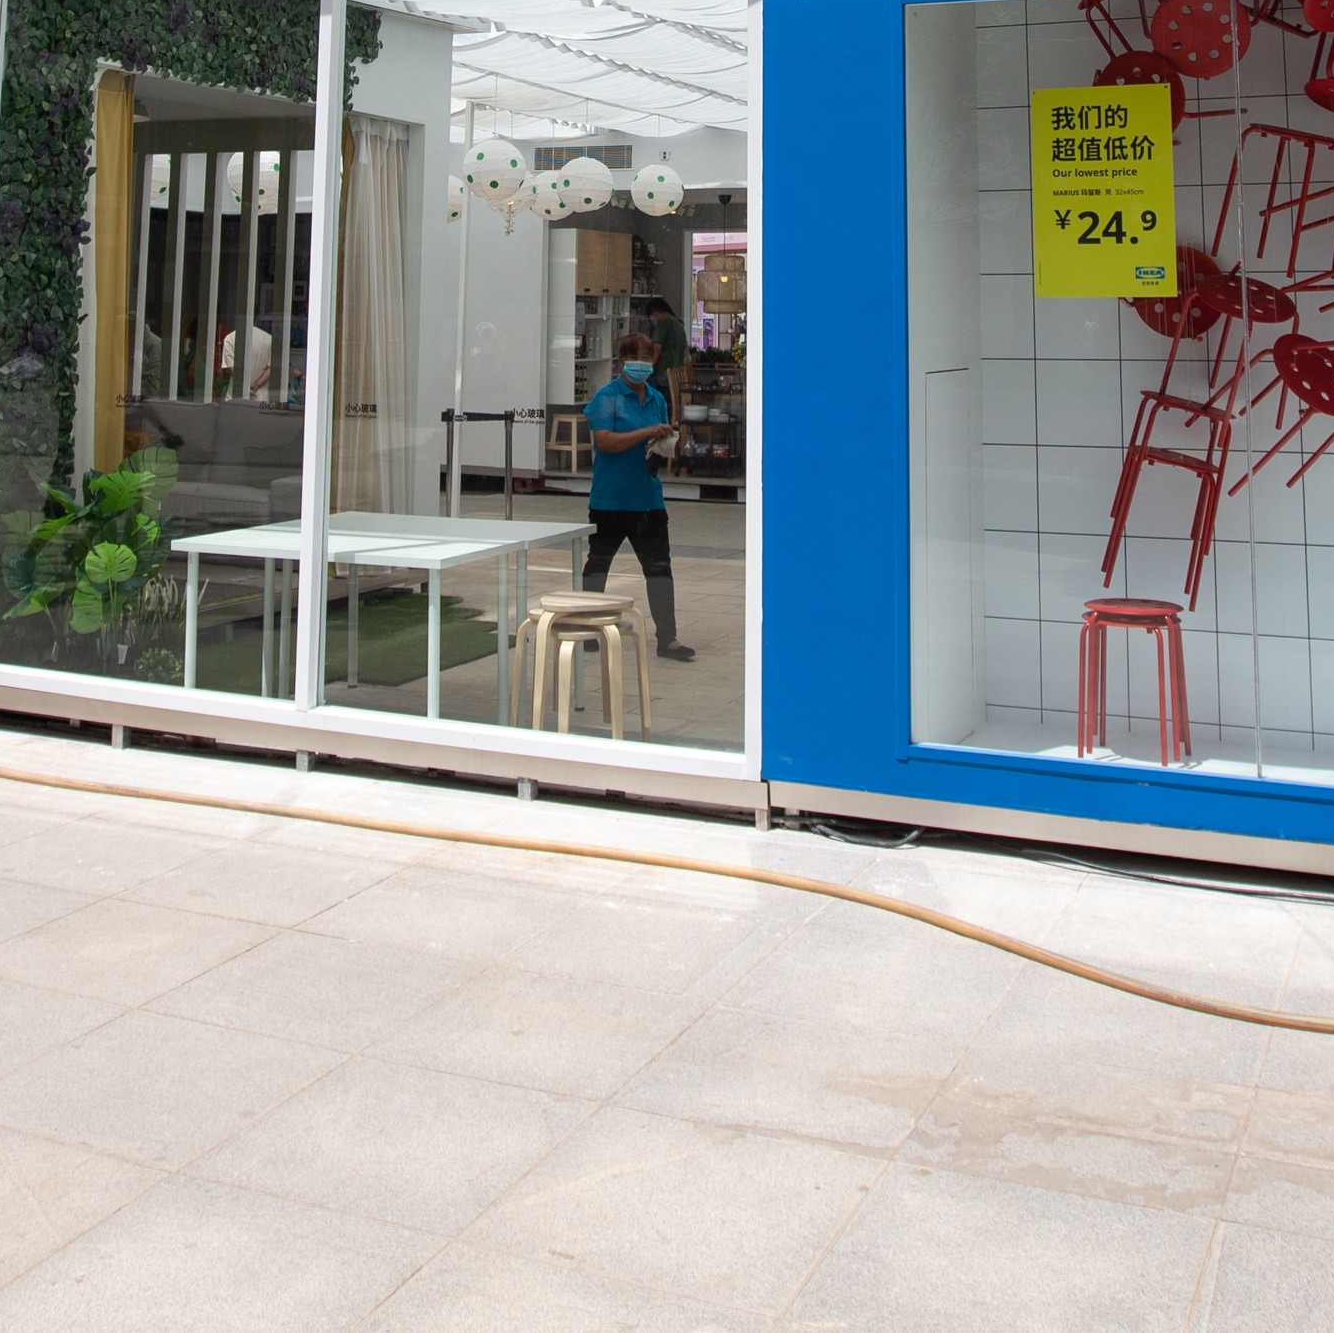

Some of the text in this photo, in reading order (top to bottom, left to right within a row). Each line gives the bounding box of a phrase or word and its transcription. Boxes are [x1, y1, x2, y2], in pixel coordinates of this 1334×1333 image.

[1051, 104, 1129, 131] 我们的
[1051, 135, 1155, 162] 超值低价
[1052, 167, 1138, 179] Our lowest price
